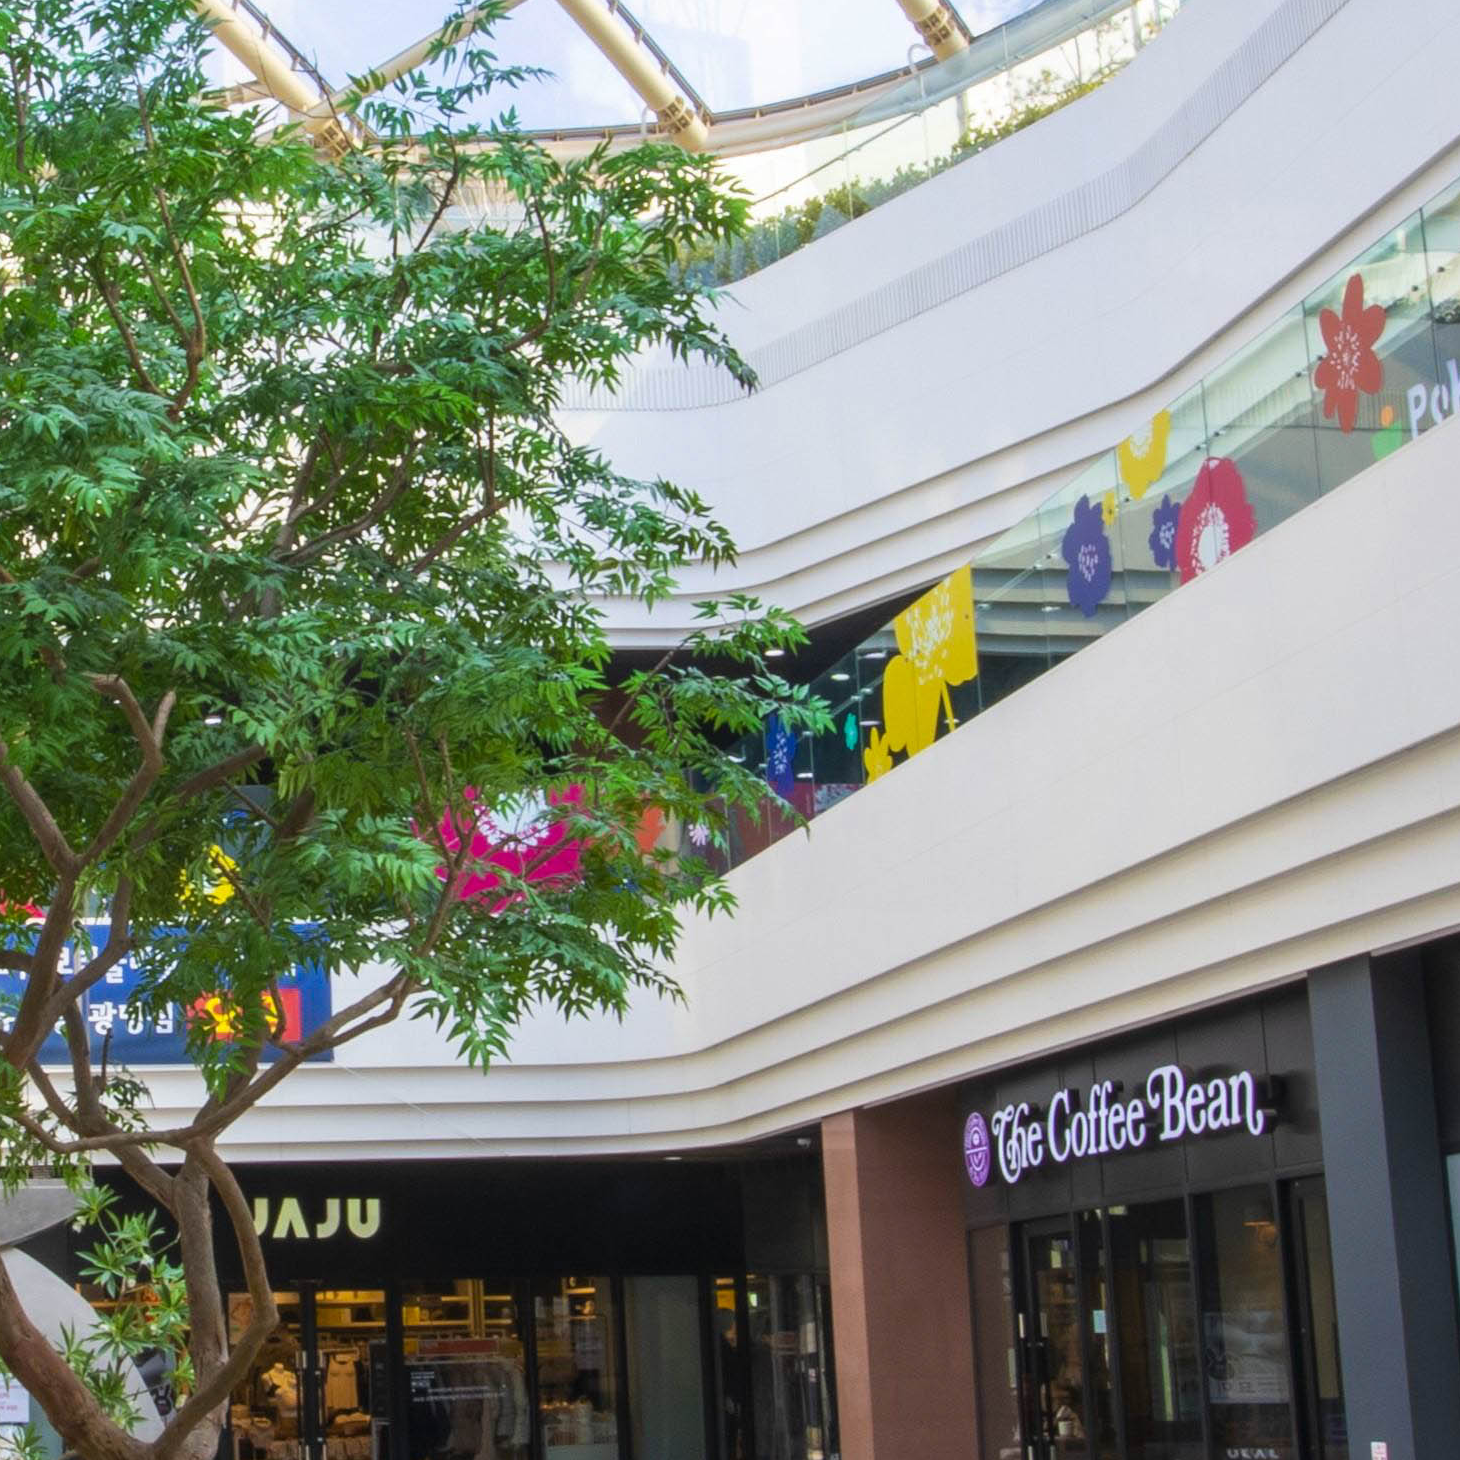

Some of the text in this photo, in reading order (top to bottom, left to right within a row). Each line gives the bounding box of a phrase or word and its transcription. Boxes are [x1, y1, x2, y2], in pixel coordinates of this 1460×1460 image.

[992, 1103, 1043, 1184] The
[1047, 1080, 1145, 1162] Coffee
[1146, 1064, 1265, 1140] Bean
[253, 1197, 380, 1239] JAJU
